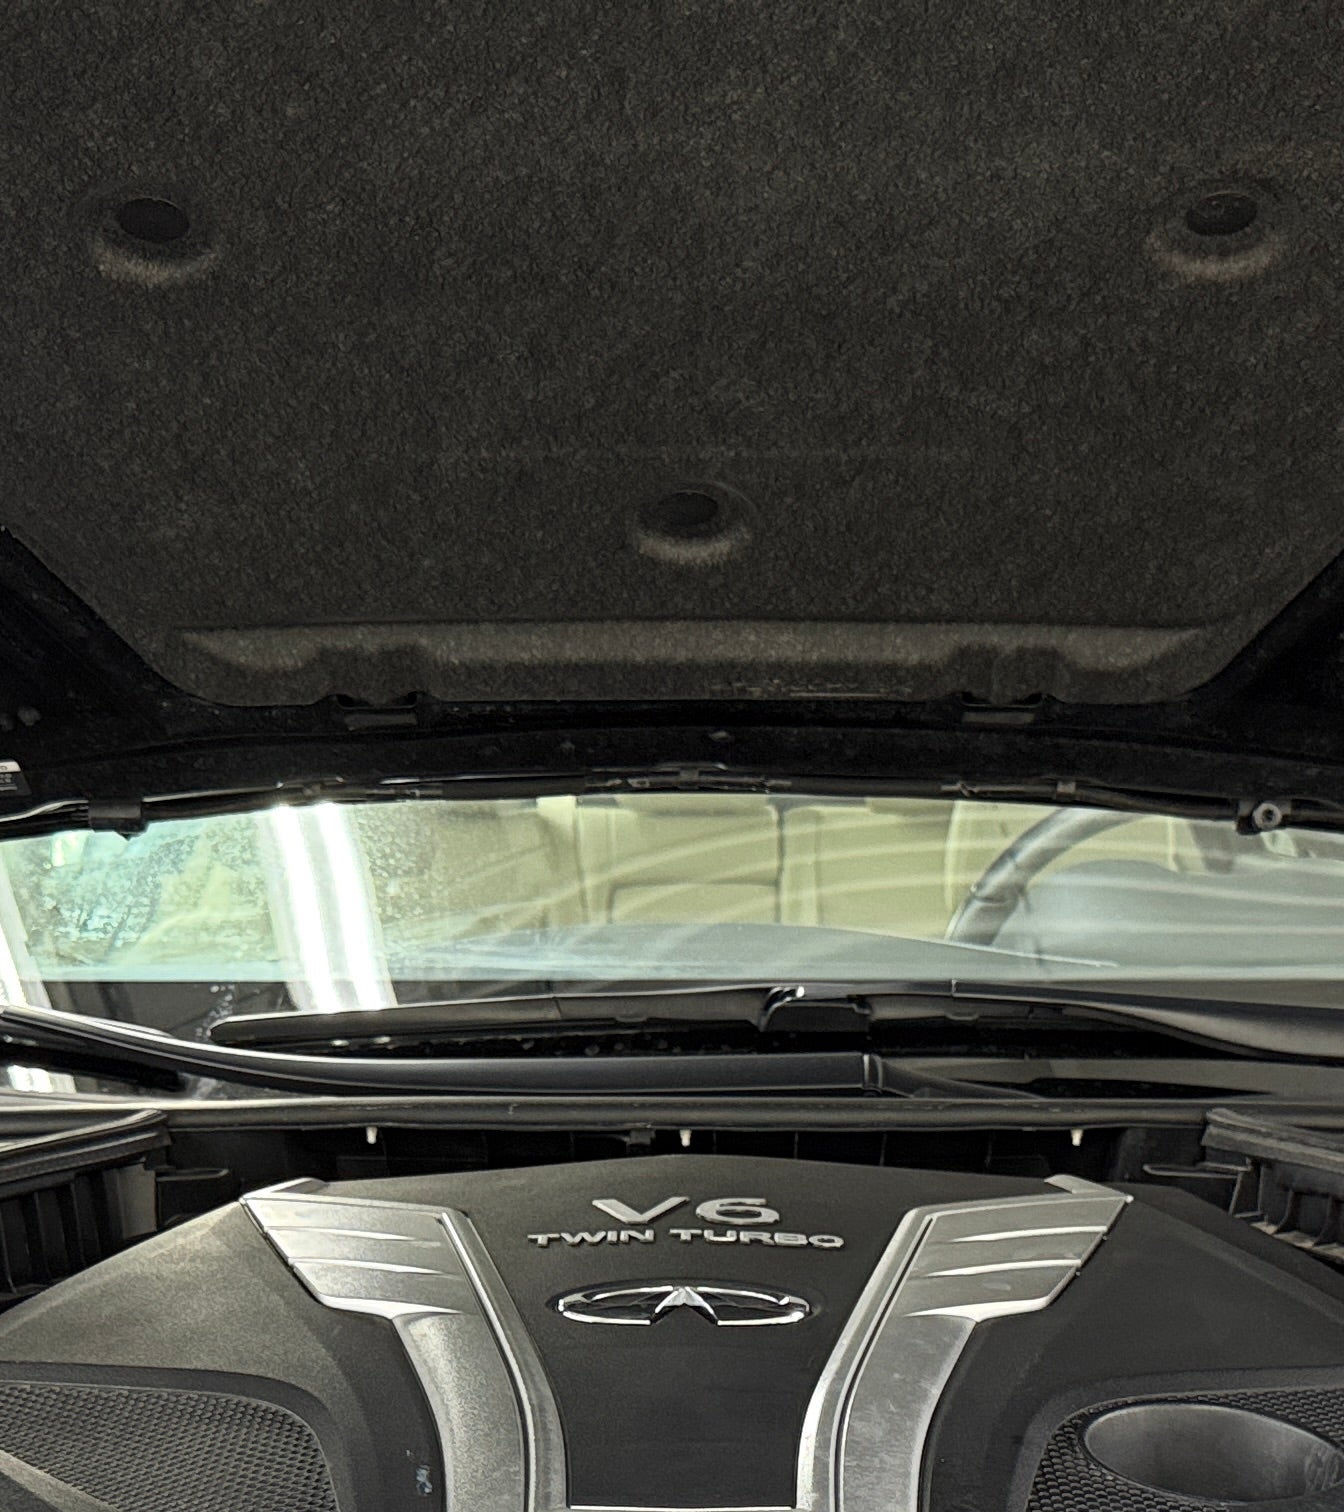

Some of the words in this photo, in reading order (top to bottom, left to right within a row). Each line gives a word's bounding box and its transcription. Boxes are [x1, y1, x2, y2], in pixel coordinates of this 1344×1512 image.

[591, 1195, 780, 1227] V6
[527, 1228, 656, 1248] TWIN
[668, 1227, 845, 1249] TURBO
